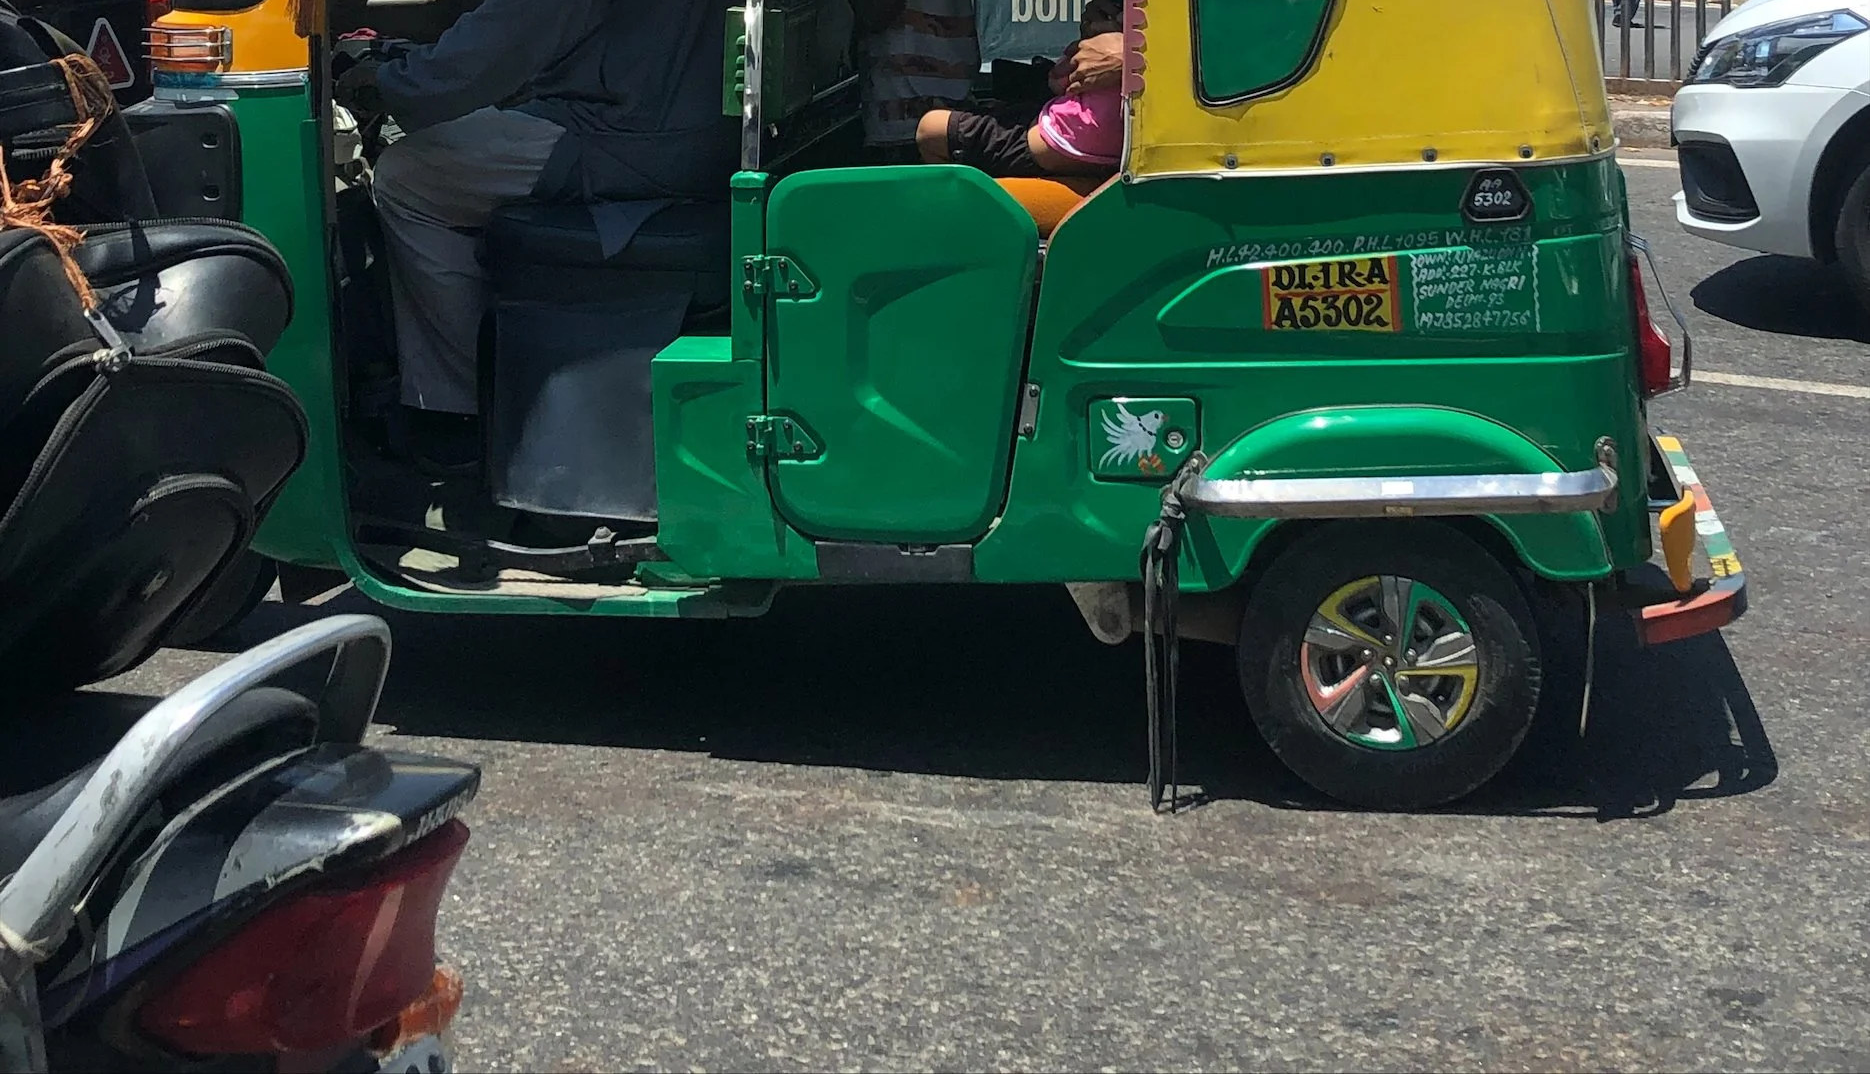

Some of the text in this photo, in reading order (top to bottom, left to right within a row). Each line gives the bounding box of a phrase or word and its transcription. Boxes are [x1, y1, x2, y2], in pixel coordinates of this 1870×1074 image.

[1474, 190, 1512, 206] 5302
[1419, 278, 1475, 300] SUNDER
[1271, 293, 1389, 329] A5302
